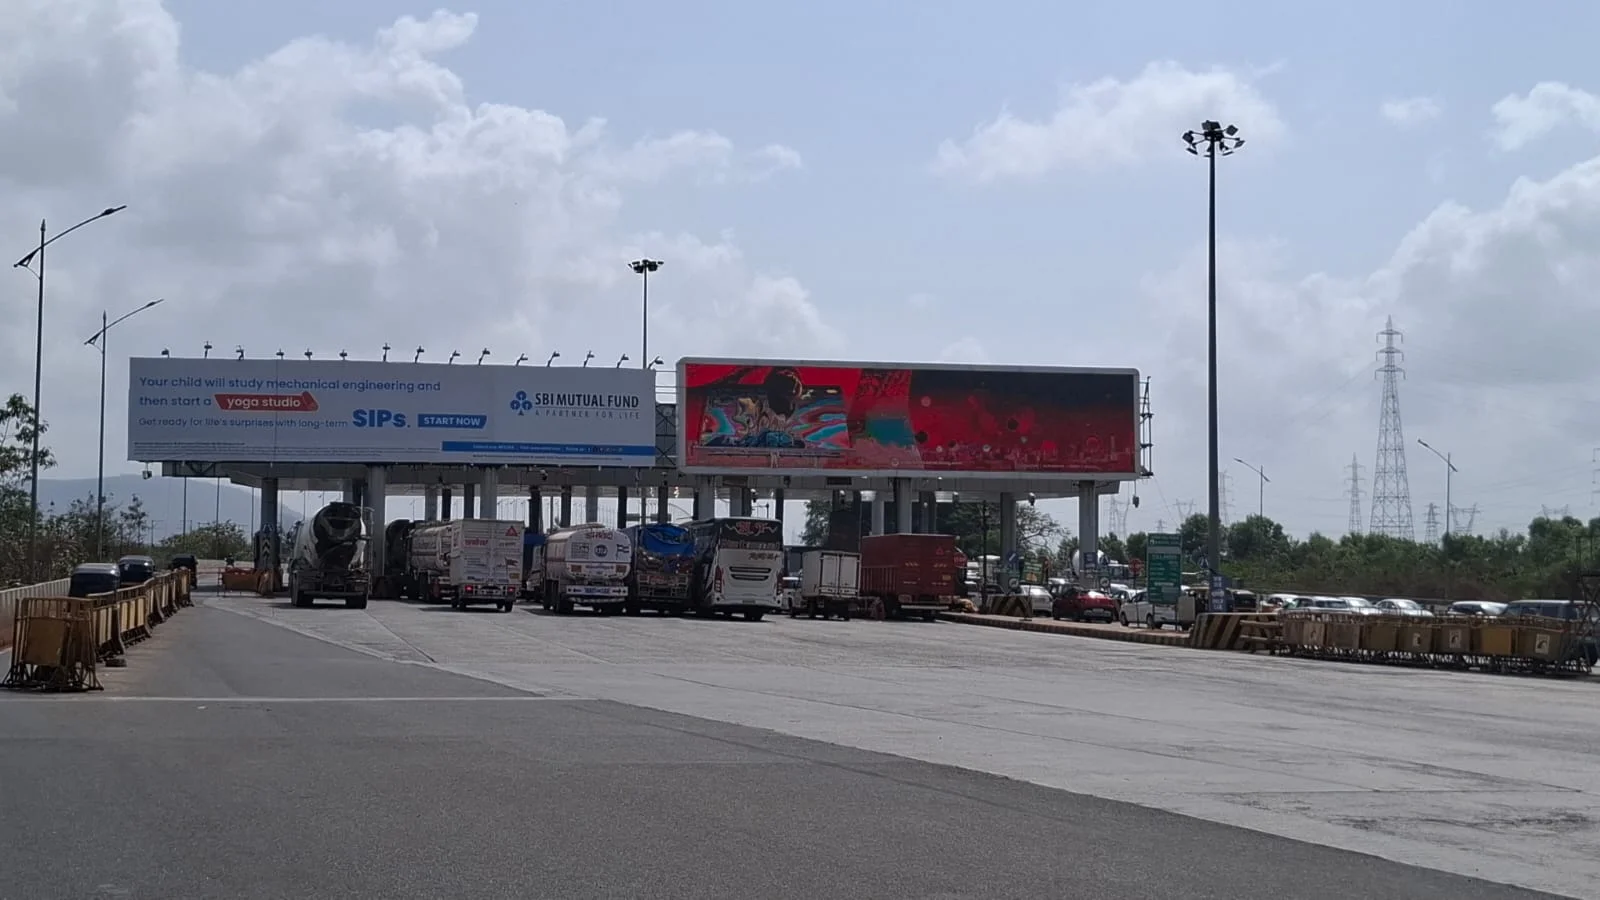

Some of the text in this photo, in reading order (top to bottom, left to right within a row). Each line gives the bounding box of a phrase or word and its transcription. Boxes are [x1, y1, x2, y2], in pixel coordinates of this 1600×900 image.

[139, 377, 441, 393] Your child will study mechanical engineering and
[139, 396, 301, 409] then start a yoga studio
[535, 392, 639, 408] SBI MUTUAL FUND
[139, 408, 411, 430] Get ready for life's surprises with long-term SIPs.
[423, 416, 481, 426] START NOW
[546, 410, 590, 418] PARTNER
[595, 411, 613, 419] FOR
[619, 411, 640, 420] LIFE
